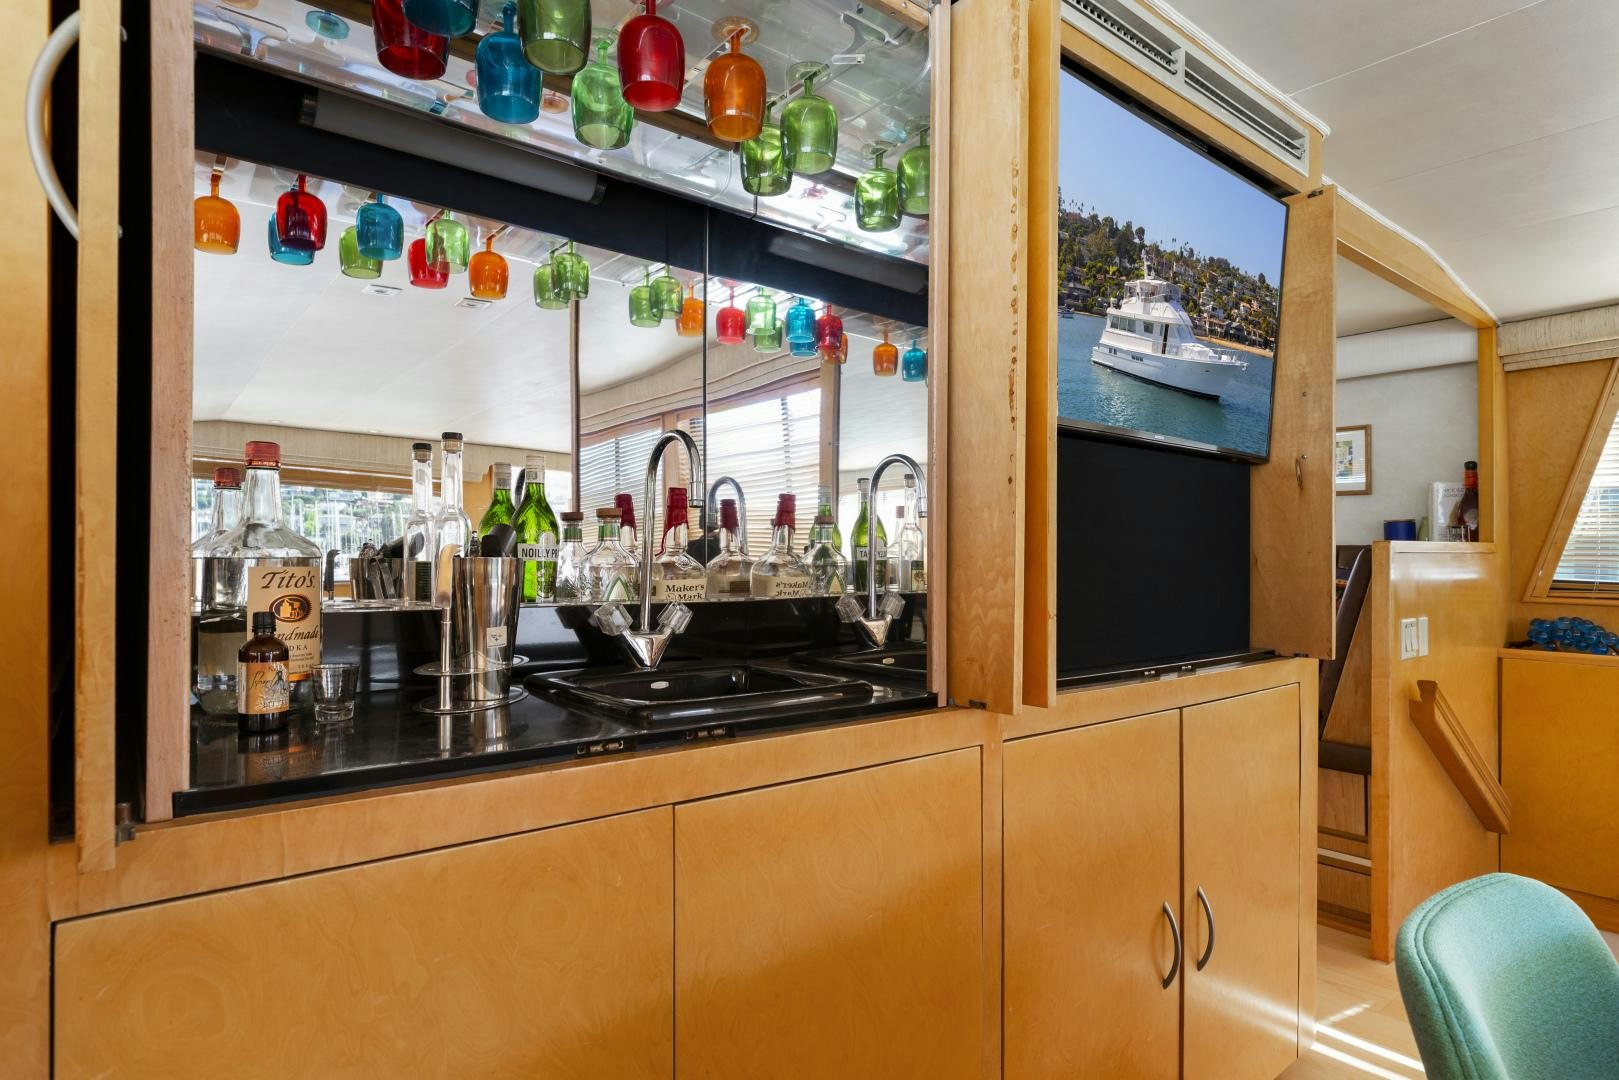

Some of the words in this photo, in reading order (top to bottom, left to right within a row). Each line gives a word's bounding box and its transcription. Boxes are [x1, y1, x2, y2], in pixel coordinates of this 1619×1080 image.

[261, 569, 316, 589] Tito's
[665, 584, 705, 592] Maker's
[677, 592, 703, 600] Mark
[276, 624, 319, 641] ndmade
